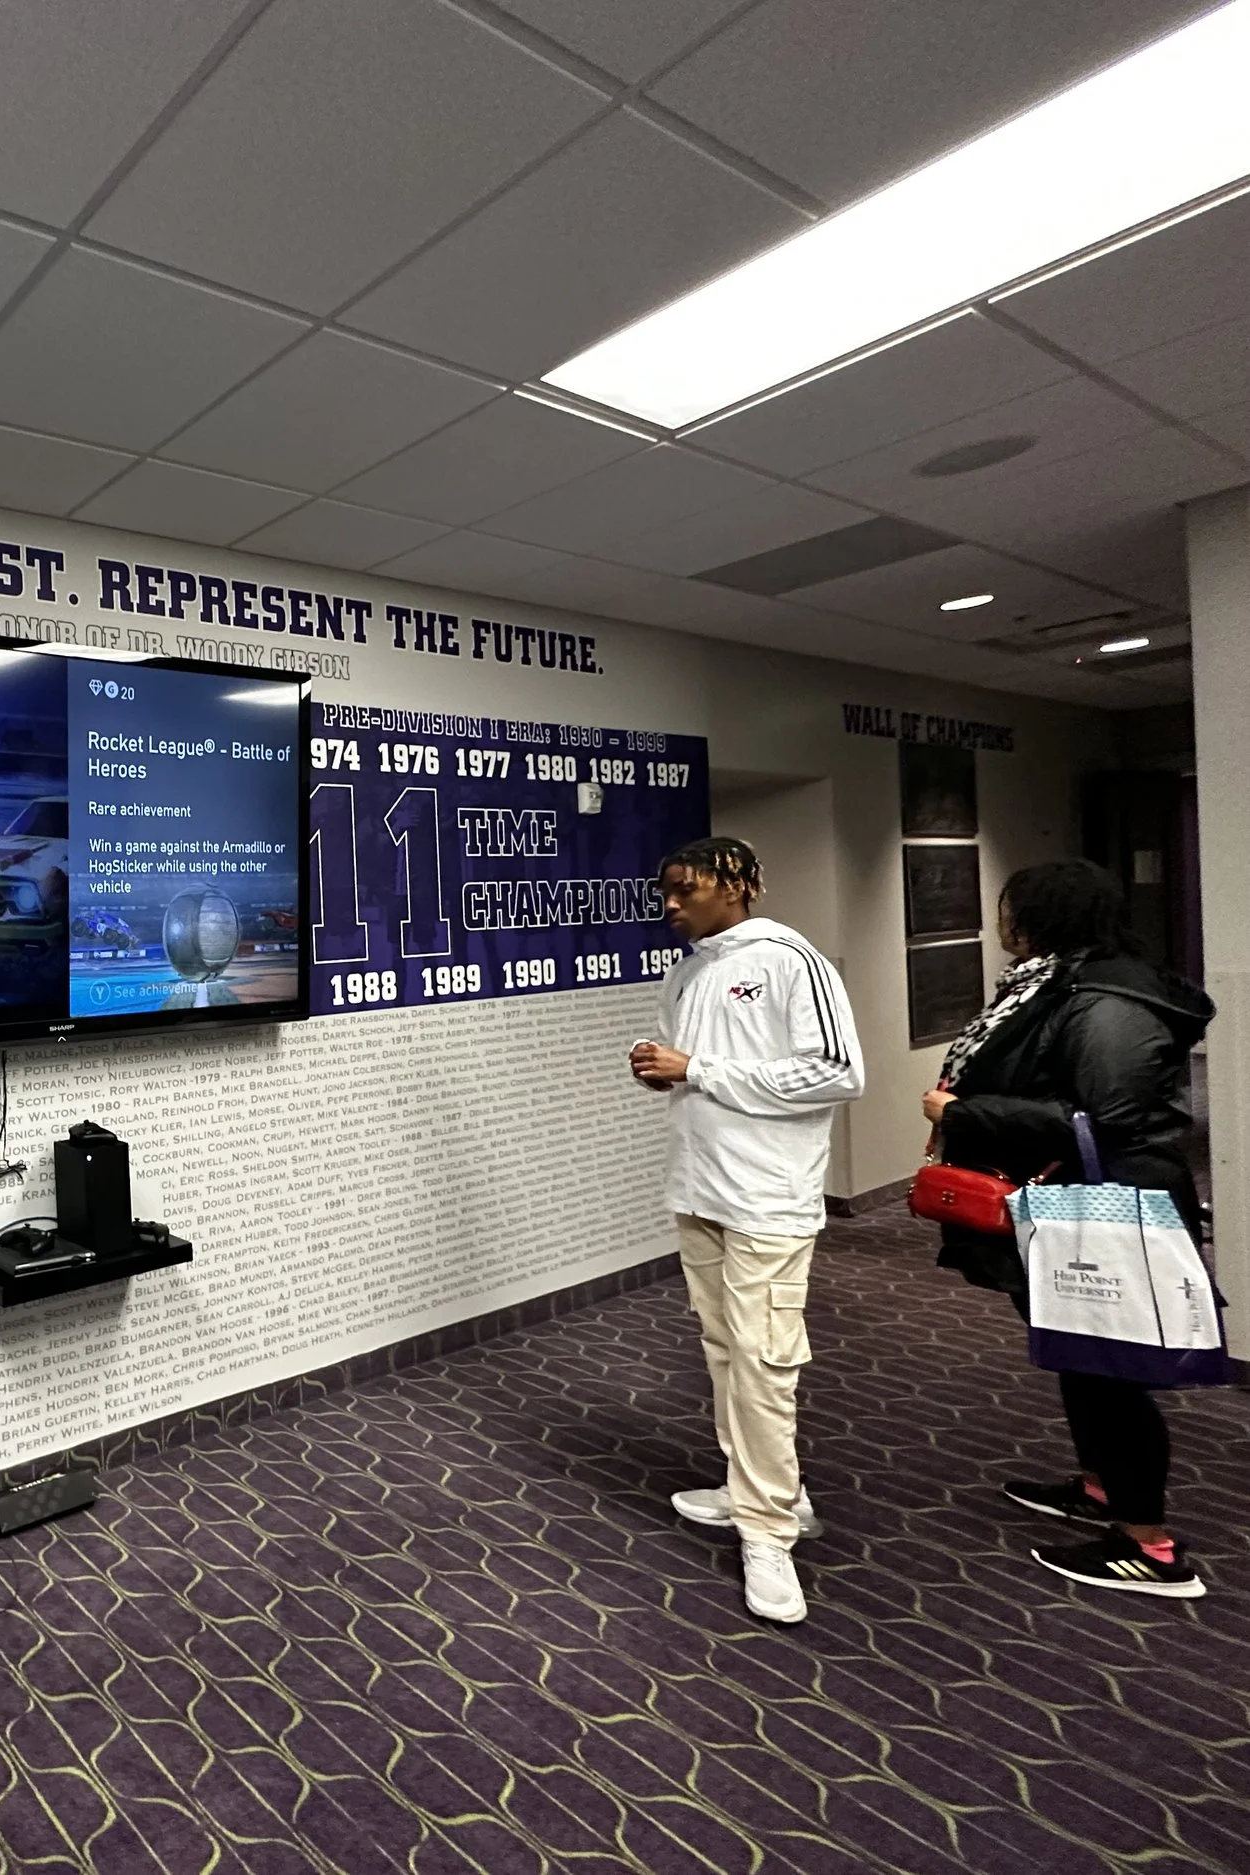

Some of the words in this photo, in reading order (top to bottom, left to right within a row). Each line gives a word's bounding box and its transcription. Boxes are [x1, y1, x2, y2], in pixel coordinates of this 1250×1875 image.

[97, 557, 373, 645] REPRESENT
[386, 605, 460, 658] THE
[468, 618, 605, 676] FUTURE.
[85, 624, 120, 649] OF
[177, 635, 268, 667] WOODY
[270, 647, 350, 681] GIBSON
[121, 687, 135, 700] 20
[323, 703, 483, 738] PRE-DIVISION
[490, 719, 499, 740] I
[506, 721, 552, 744] ERA:
[558, 724, 602, 749] 1930
[626, 731, 667, 753] 1999
[842, 703, 896, 738] WALL
[900, 712, 922, 740] OF
[88, 731, 144, 753] Rocket
[232, 742, 273, 761] Battle
[277, 745, 291, 762] of
[310, 738, 361, 771] 974
[378, 742, 440, 776] 1976
[455, 748, 511, 780] 1977
[525, 753, 577, 782] 1980
[589, 757, 636, 786] 1982
[647, 762, 690, 788] 1987
[88, 758, 147, 779] Heroes
[89, 801, 117, 816] Rare
[120, 802, 191, 818] achievement
[89, 838, 112, 853] Win
[115, 842, 123, 853] a
[125, 841, 157, 856] game
[160, 840, 200, 856] against
[203, 840, 220, 853] the
[222, 840, 272, 854] Armadillo
[275, 843, 286, 854] or
[457, 807, 558, 857] TIME
[89, 859, 153, 875] HogSticker
[156, 860, 186, 873] while
[189, 860, 218, 875] using
[220, 859, 237, 873] the
[240, 859, 267, 873] other
[310, 783, 451, 965] 11
[89, 880, 132, 894] vehicle
[462, 878, 665, 931] CHAMPIONS
[114, 985, 136, 998] See
[330, 970, 397, 1006] 1988
[421, 964, 481, 996] 1989
[502, 958, 556, 989] 1990
[575, 952, 622, 982] 1991
[331, 1018, 347, 1027] JOE
[350, 1011, 410, 1025] RAMSBOTHAM,
[411, 1009, 437, 1018] DARYL
[1079, 1271, 1122, 1287] POINT
[16, 1432, 58, 1453] PERRY
[60, 1420, 103, 1440] WHITE,
[108, 1408, 140, 1425] MIKE
[144, 1394, 182, 1414] WILSON
